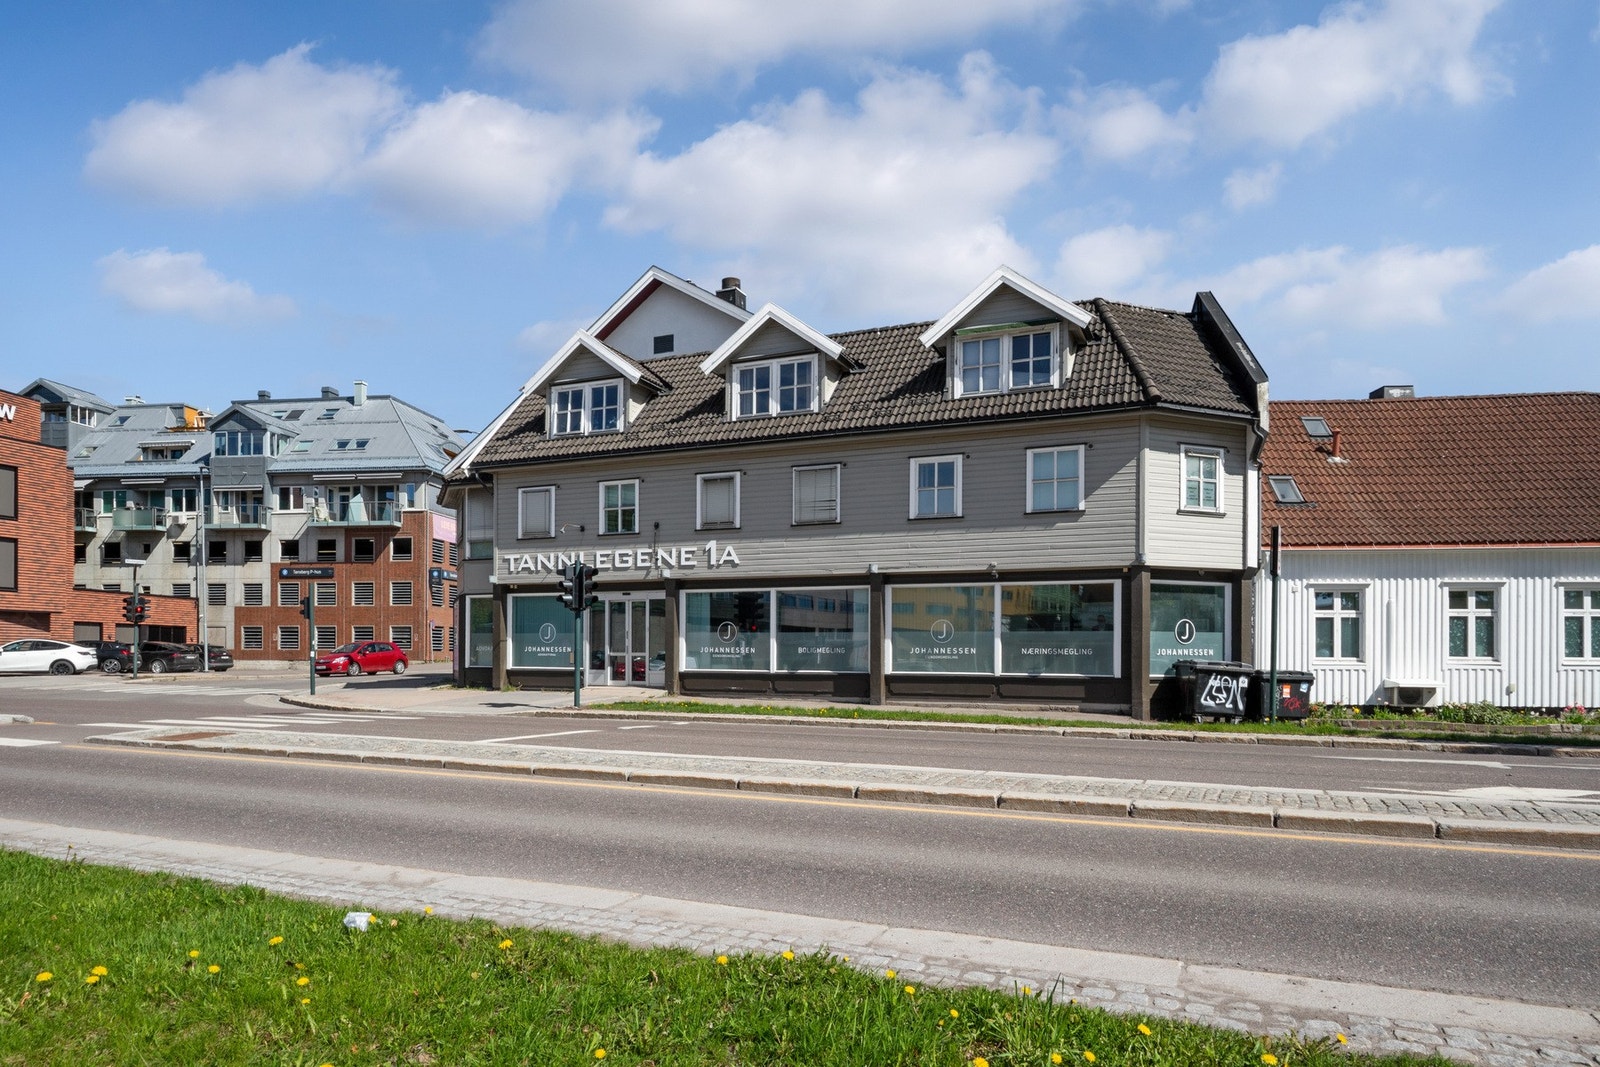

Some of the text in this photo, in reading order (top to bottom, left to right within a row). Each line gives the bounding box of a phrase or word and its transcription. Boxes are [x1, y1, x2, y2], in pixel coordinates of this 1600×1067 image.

[706, 540, 740, 565] 1A
[700, 646, 756, 654] JOHANNESSEN
[797, 646, 846, 654] BOLIGMEGLING
[909, 647, 976, 655] JOHANNESSEN
[1021, 647, 1093, 655] NÆRINGSMEGLING
[1156, 648, 1214, 656] JOHANNESSEN
